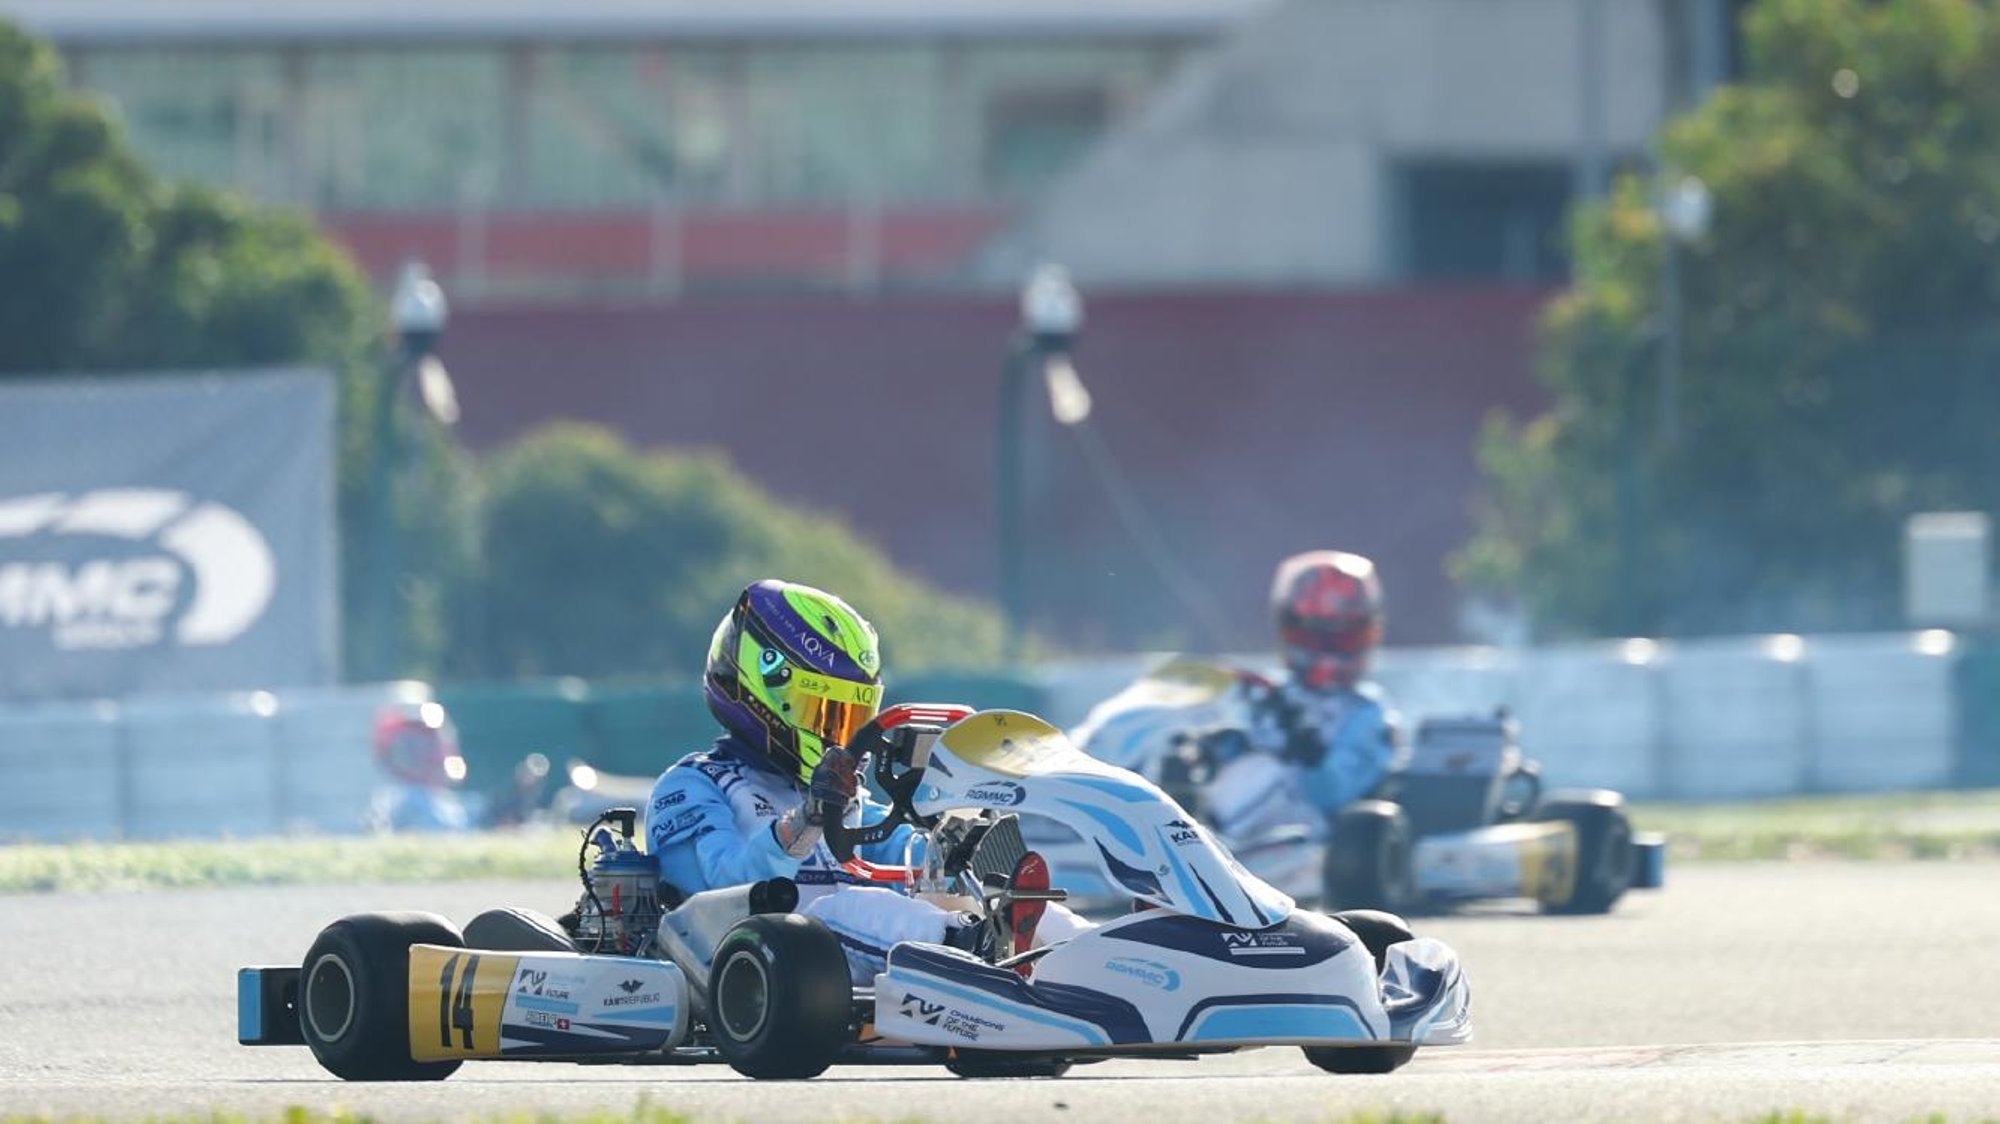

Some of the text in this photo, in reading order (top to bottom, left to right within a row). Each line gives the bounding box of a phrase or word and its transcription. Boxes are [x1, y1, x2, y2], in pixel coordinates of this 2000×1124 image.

[794, 632, 836, 669] AQVA
[965, 789, 1013, 802] RGMMC
[440, 954, 481, 1050] 14
[950, 1010, 1006, 1031] CHAMPIONS
[943, 1024, 979, 1041] FUTURE
